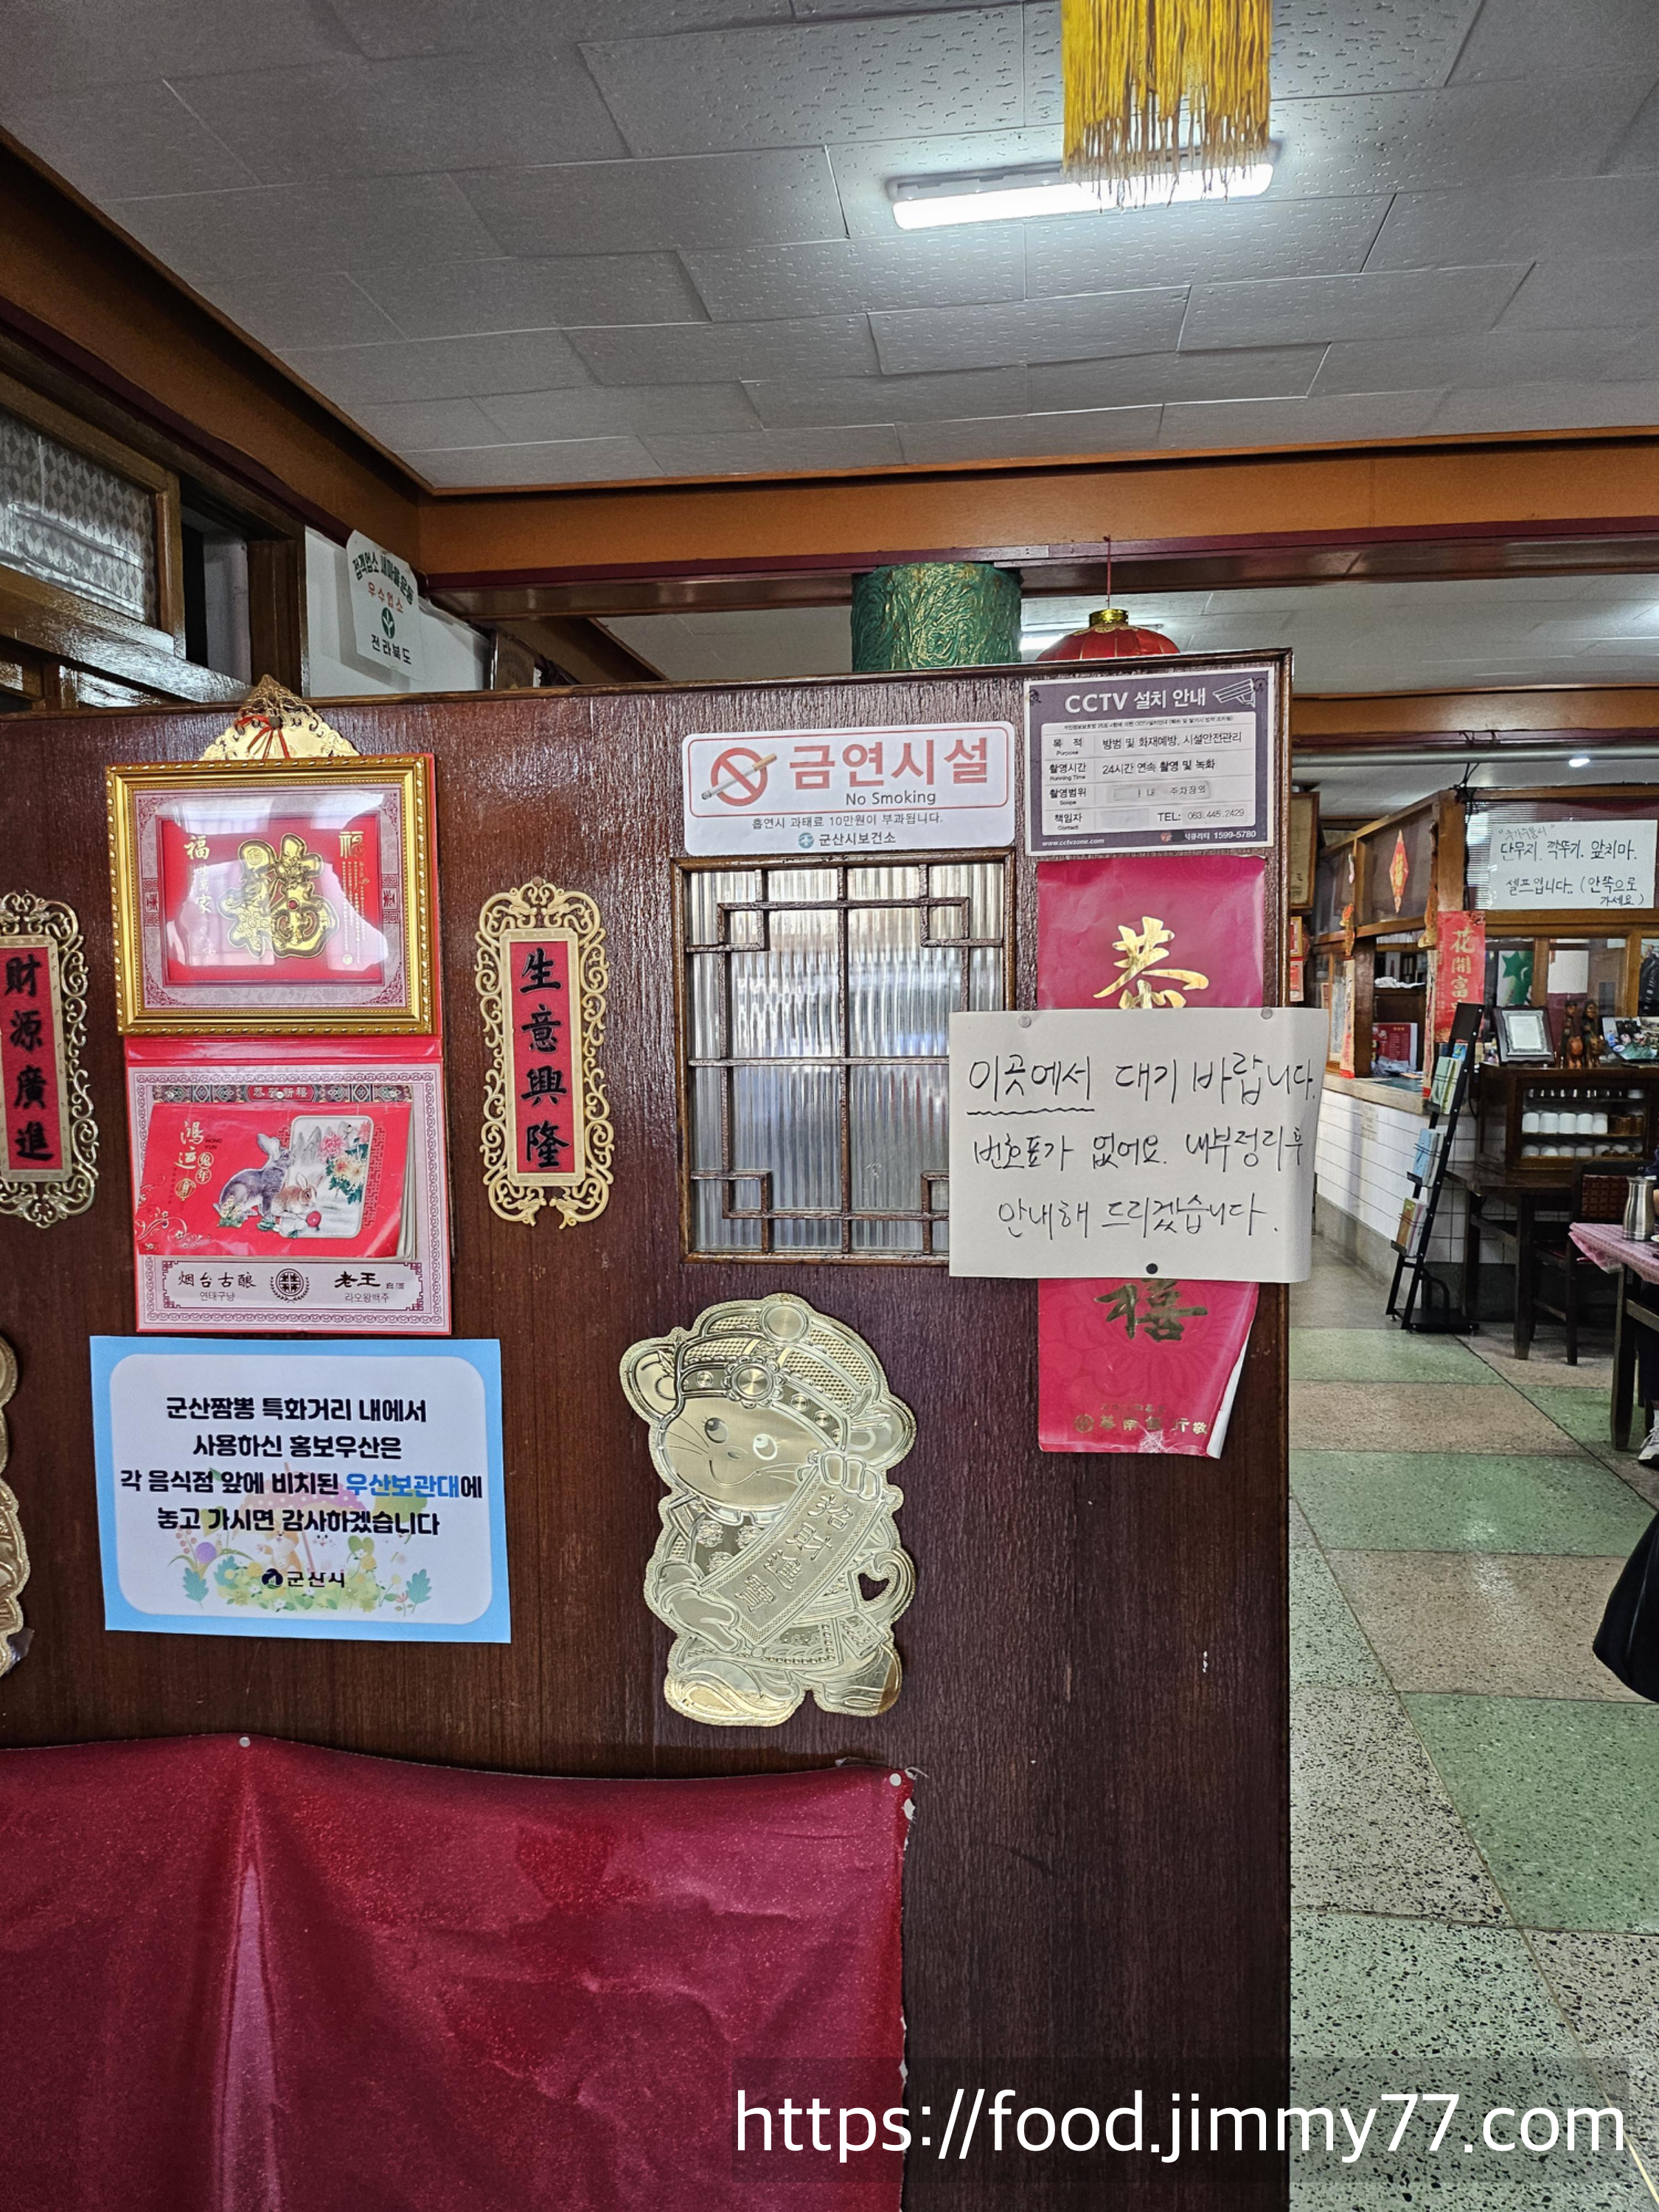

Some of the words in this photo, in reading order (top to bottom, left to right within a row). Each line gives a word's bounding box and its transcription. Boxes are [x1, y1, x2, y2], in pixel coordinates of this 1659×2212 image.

[368, 581, 404, 613] 우수업소
[371, 633, 412, 665] 전라북도
[1065, 691, 1128, 714] CCTV
[1133, 690, 1167, 709] 설치
[1172, 687, 1207, 707] 안내
[1102, 739, 1121, 750] 방범
[1126, 738, 1135, 748] 및
[1138, 734, 1180, 748] 화재예방,
[1183, 731, 1242, 744] 시설안전관리
[789, 737, 989, 790] 금연시설
[1049, 762, 1087, 773] 촬영시간
[1102, 763, 1134, 774] 24시간
[1137, 762, 1156, 773] 연속
[1182, 759, 1192, 771] 및
[1195, 758, 1215, 769] 녹화
[846, 793, 866, 805] No
[872, 790, 936, 806] Smoking
[1049, 787, 1087, 799] 촬영범위
[751, 816, 786, 830] 흡연시
[790, 815, 824, 829] 과태료
[829, 814, 877, 827] 10만원이
[881, 812, 944, 825] 부과됩니다.
[1054, 813, 1082, 824] 책임자
[1158, 811, 1181, 822] TEL:
[818, 832, 897, 847] 군산시보건소
[1214, 830, 1256, 839] 1599-5780
[1590, 839, 1637, 860] 앞치마.
[1450, 926, 1476, 1008] 花開富
[4, 953, 55, 1161] 財源廣進
[519, 947, 570, 1169] 生意興隆
[969, 1054, 1091, 1101] 이곳에서
[1115, 1059, 1176, 1103] 대기
[1192, 1051, 1316, 1106] 바랍니다.
[1092, 1133, 1167, 1170] 없어요.
[998, 1198, 1089, 1240] 안내해
[1101, 1192, 1279, 1239] 드리겠습니다.
[335, 1271, 380, 1288] 老王
[166, 1397, 255, 1421] 군산짬뽕
[262, 1397, 352, 1422] 특화거리
[358, 1399, 428, 1423] 내에서
[192, 1434, 283, 1458] 사용하신
[289, 1435, 402, 1460] 홍보우산은
[121, 1470, 142, 1492] 각
[147, 1470, 213, 1494] 음식점
[220, 1472, 264, 1495] 앞에
[272, 1472, 339, 1496] 비치된
[346, 1472, 483, 1500] 우산보관대에
[156, 1507, 201, 1529] 놓고
[208, 1508, 275, 1532] 가시면
[282, 1509, 441, 1536] 감사하겠습니다
[286, 1571, 346, 1588] 군산시
